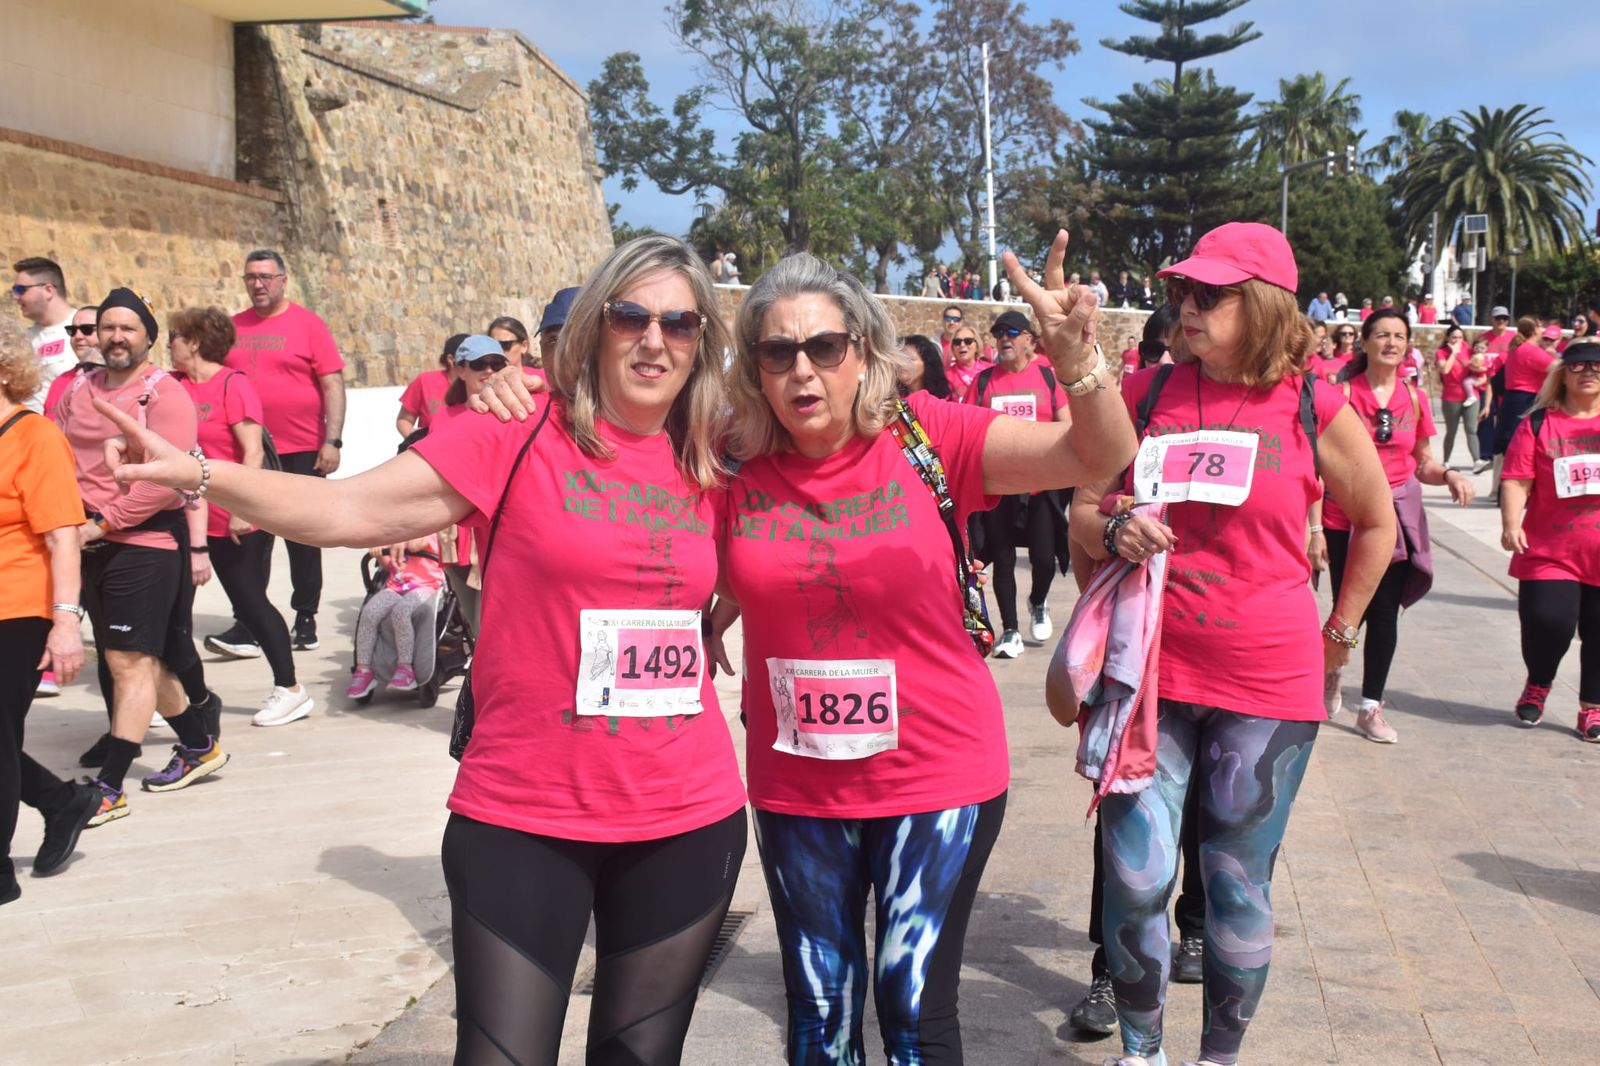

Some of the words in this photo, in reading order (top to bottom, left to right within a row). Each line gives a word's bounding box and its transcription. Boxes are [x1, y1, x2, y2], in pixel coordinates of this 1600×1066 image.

[1003, 405, 1034, 417] 1593
[1187, 451, 1227, 477] 78
[563, 496, 601, 519] DE
[779, 480, 905, 525] CARRERA
[732, 513, 765, 540] DE
[810, 503, 910, 540] MUJER
[620, 618, 657, 628] CARRERA
[657, 619, 665, 628] DE
[665, 619, 674, 628] LA
[620, 644, 698, 680] 1492
[795, 668, 828, 677] CARRERA
[829, 669, 840, 677] DE
[840, 668, 851, 677] LA
[851, 667, 880, 676] MUJER
[798, 691, 890, 726] 1826
